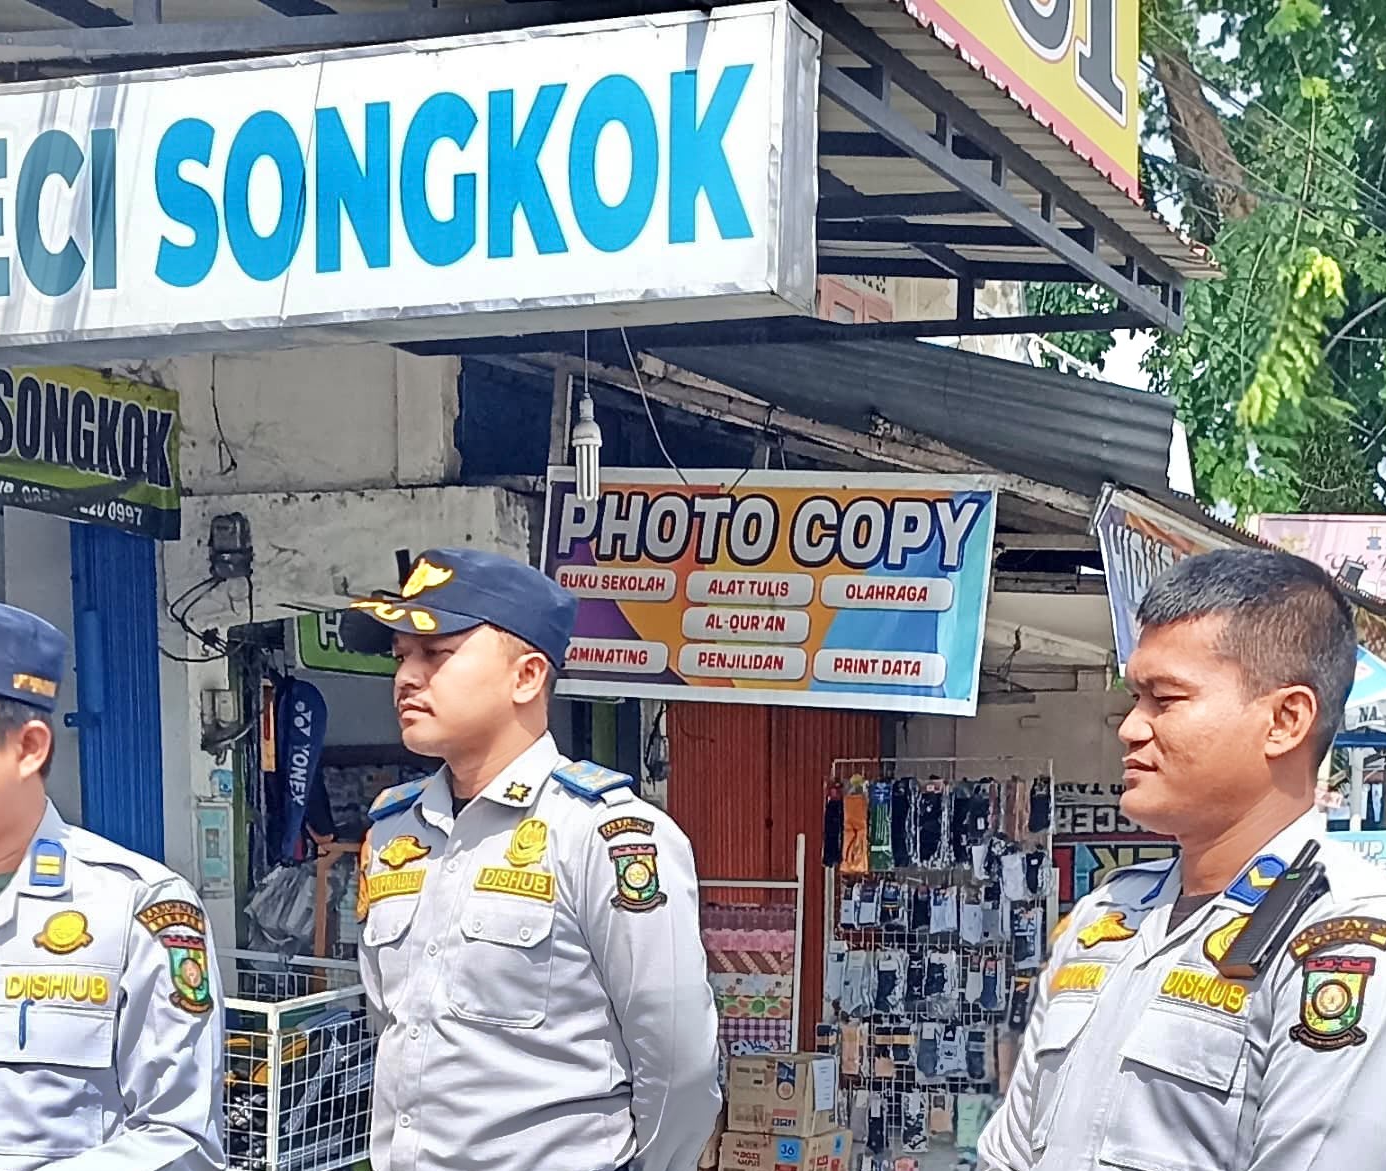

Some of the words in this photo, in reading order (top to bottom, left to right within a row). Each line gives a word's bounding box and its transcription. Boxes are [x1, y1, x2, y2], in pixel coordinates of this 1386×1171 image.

[153, 62, 755, 288] SONGKOK
[107, 501, 143, 527] 0997
[557, 490, 778, 564] PHOTO
[791, 496, 980, 571] COPY
[560, 572, 598, 591] BUKU
[600, 573, 666, 593] SEKOLAH
[707, 578, 746, 598] ALAT
[748, 580, 790, 599] TULIS
[844, 582, 929, 603] OLAHRAGA
[704, 612, 786, 634] AL-QUR'AN
[697, 651, 785, 672] PENJILIDAN
[833, 656, 879, 676] PRINT
[881, 658, 922, 678] DATA
[288, 742, 311, 808] YONEX
[482, 868, 549, 893] DISHUB
[3, 972, 110, 1004] DISHUB
[1161, 970, 1248, 1014] DISHUB
